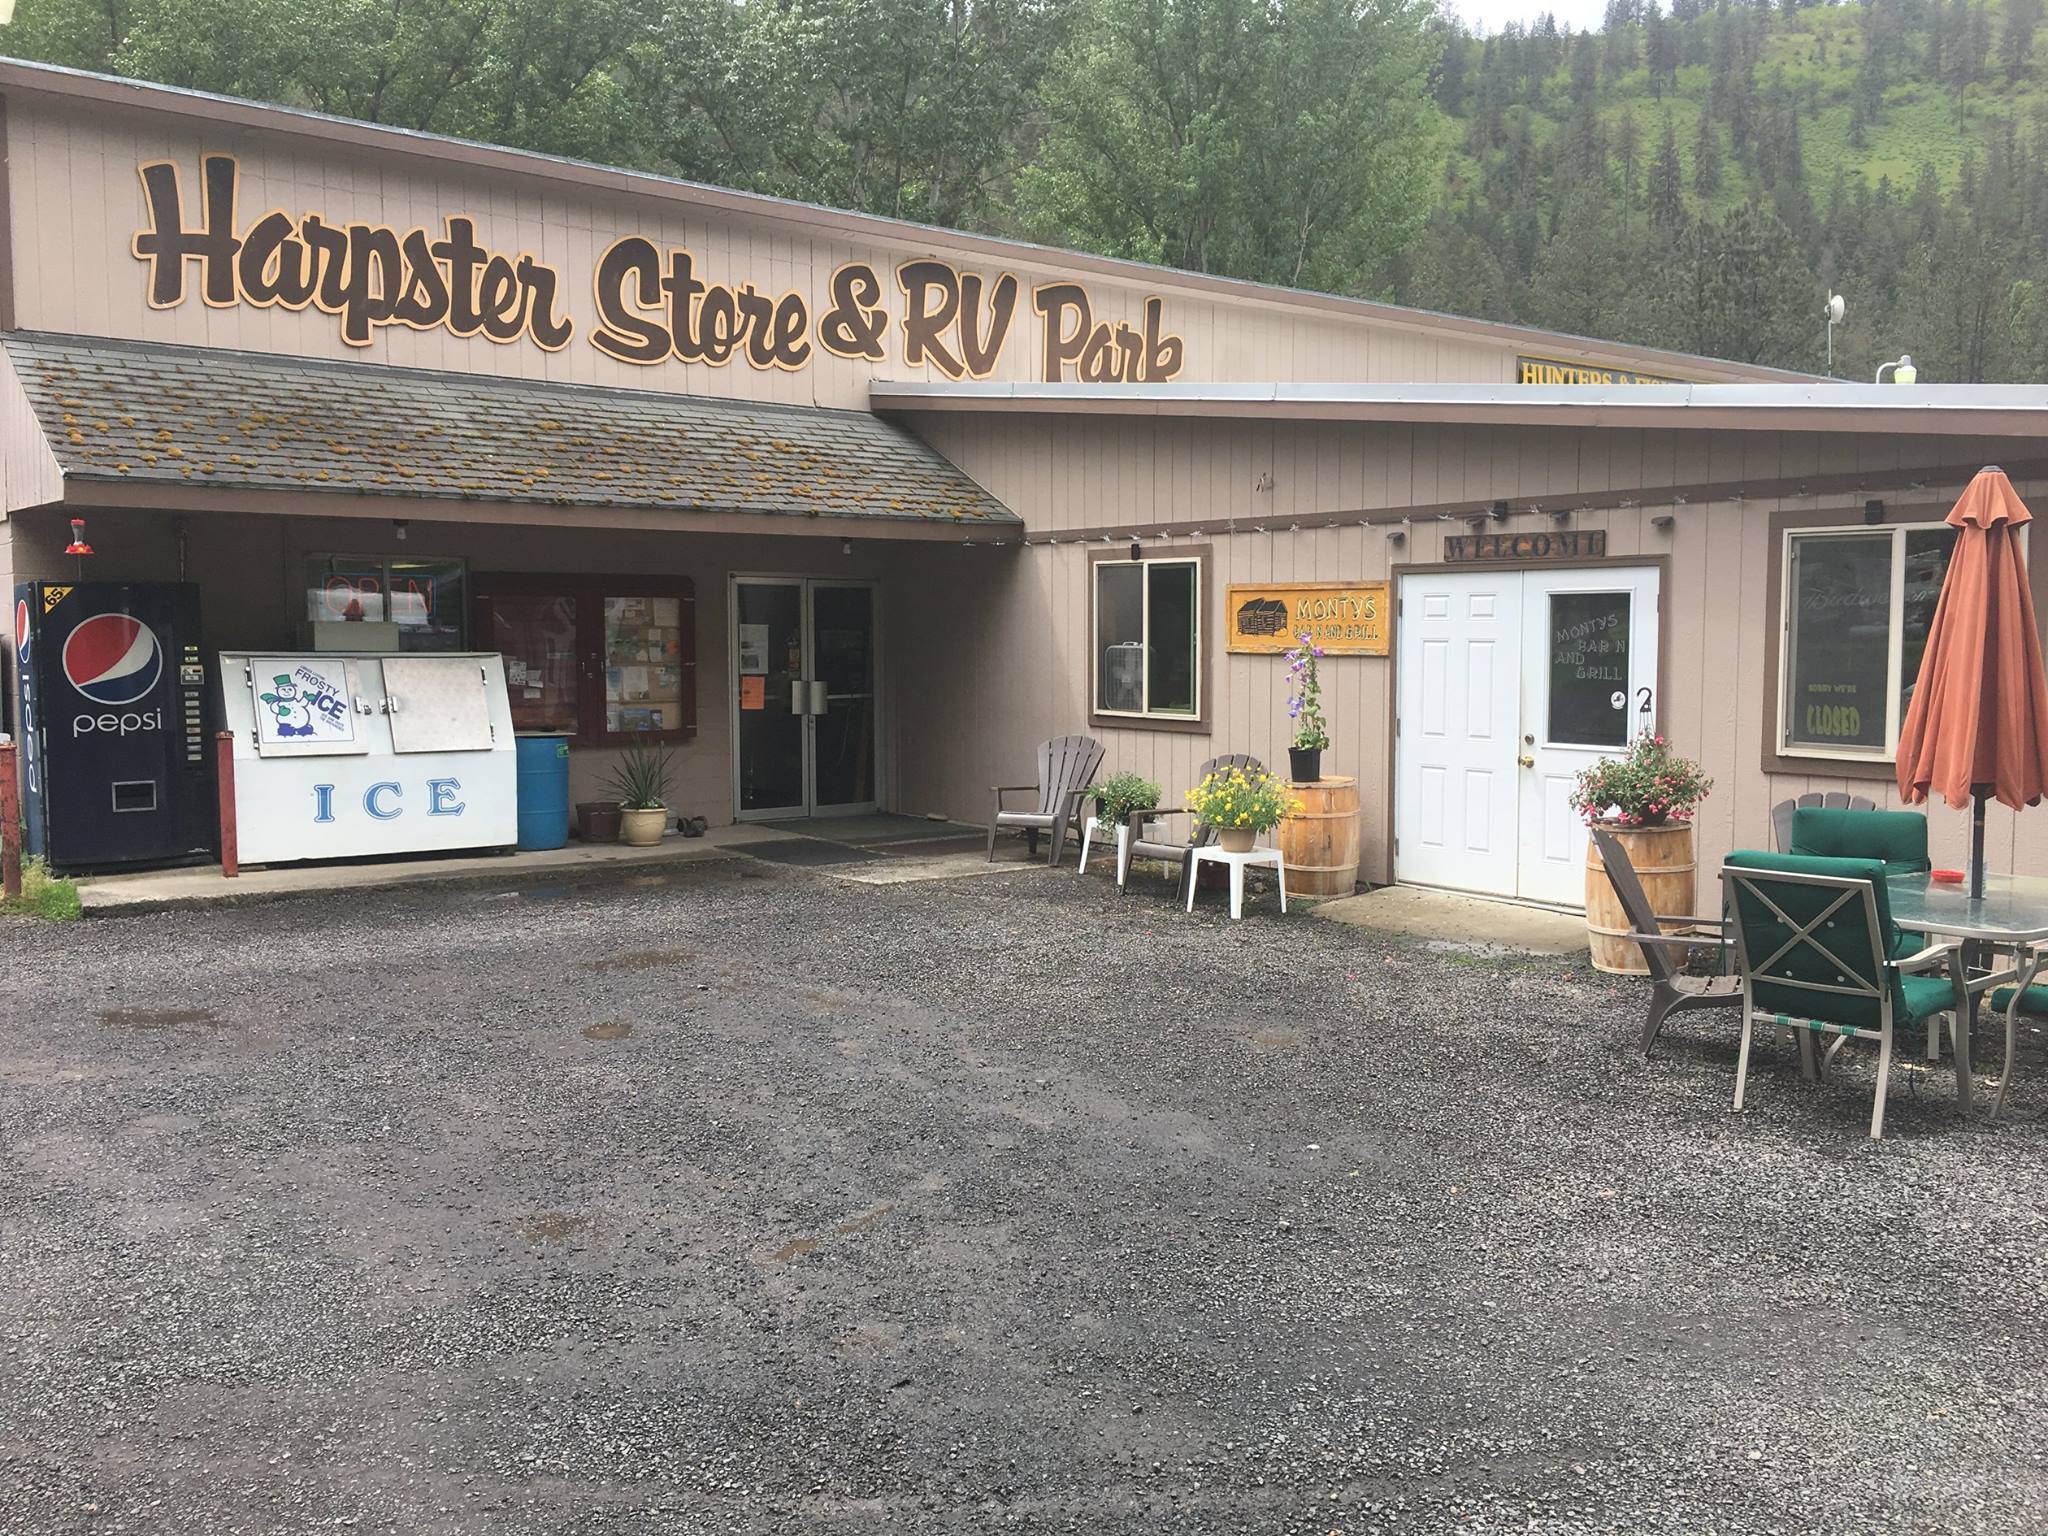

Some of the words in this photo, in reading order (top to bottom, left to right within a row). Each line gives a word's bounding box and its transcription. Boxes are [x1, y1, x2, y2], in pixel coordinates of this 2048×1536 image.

[132, 152, 574, 352] Harpster
[589, 235, 813, 371] Store
[817, 261, 887, 362] &
[896, 258, 1020, 381] RV
[1032, 281, 1184, 383] Park
[1295, 597, 1377, 621] MONTYS
[1345, 624, 1379, 640] GRILL
[1555, 613, 1619, 643] MONTYS
[1554, 652, 1586, 666] AND
[1577, 639, 1609, 653] BAR
[294, 668, 341, 697] FROSTY
[1575, 666, 1623, 681] GRILL
[310, 690, 347, 720] ICE
[73, 707, 162, 738] pepsi
[1807, 705, 1860, 736] CLOSED
[313, 777, 466, 823] ICE
